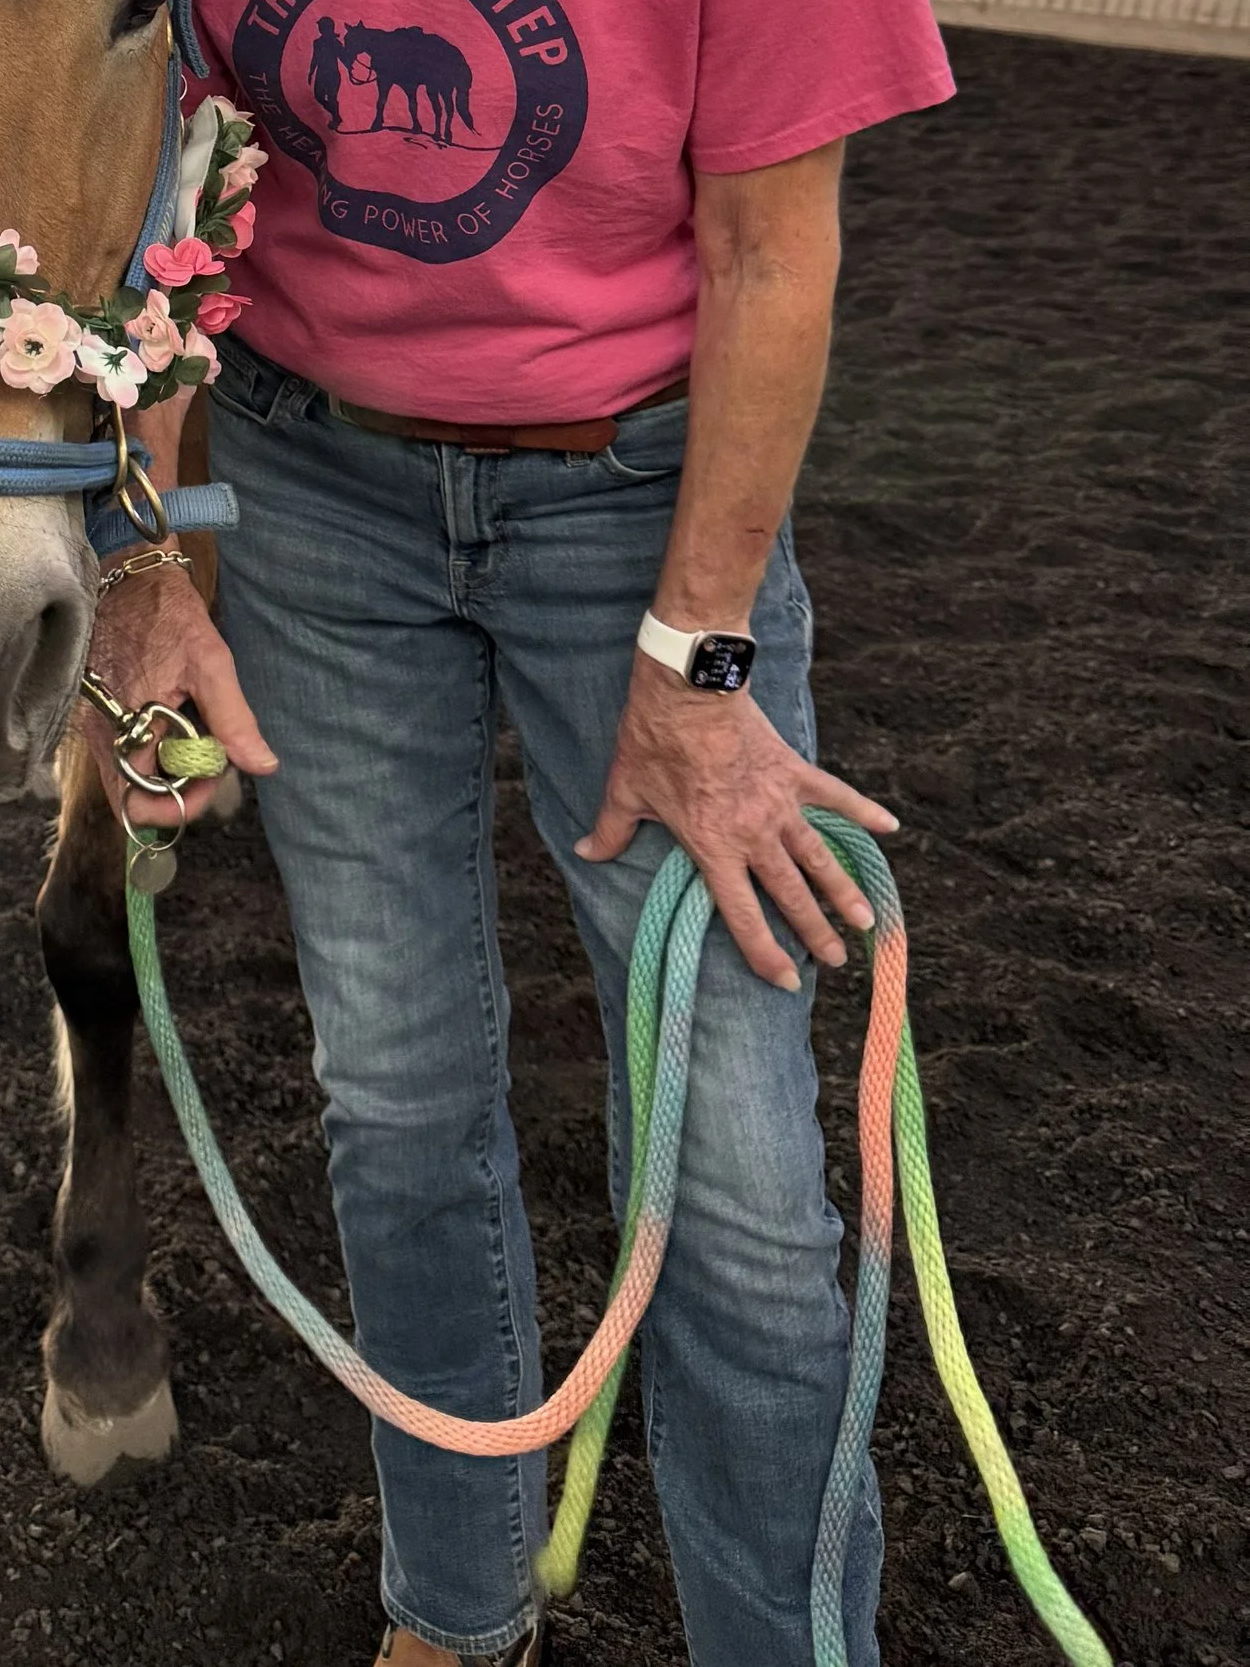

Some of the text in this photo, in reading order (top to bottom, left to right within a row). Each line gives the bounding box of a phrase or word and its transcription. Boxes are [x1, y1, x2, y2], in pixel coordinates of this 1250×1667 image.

[249, 72, 283, 116] THE
[362, 204, 449, 245] POWER
[456, 201, 493, 236] OF
[494, 101, 564, 201] HORSES
